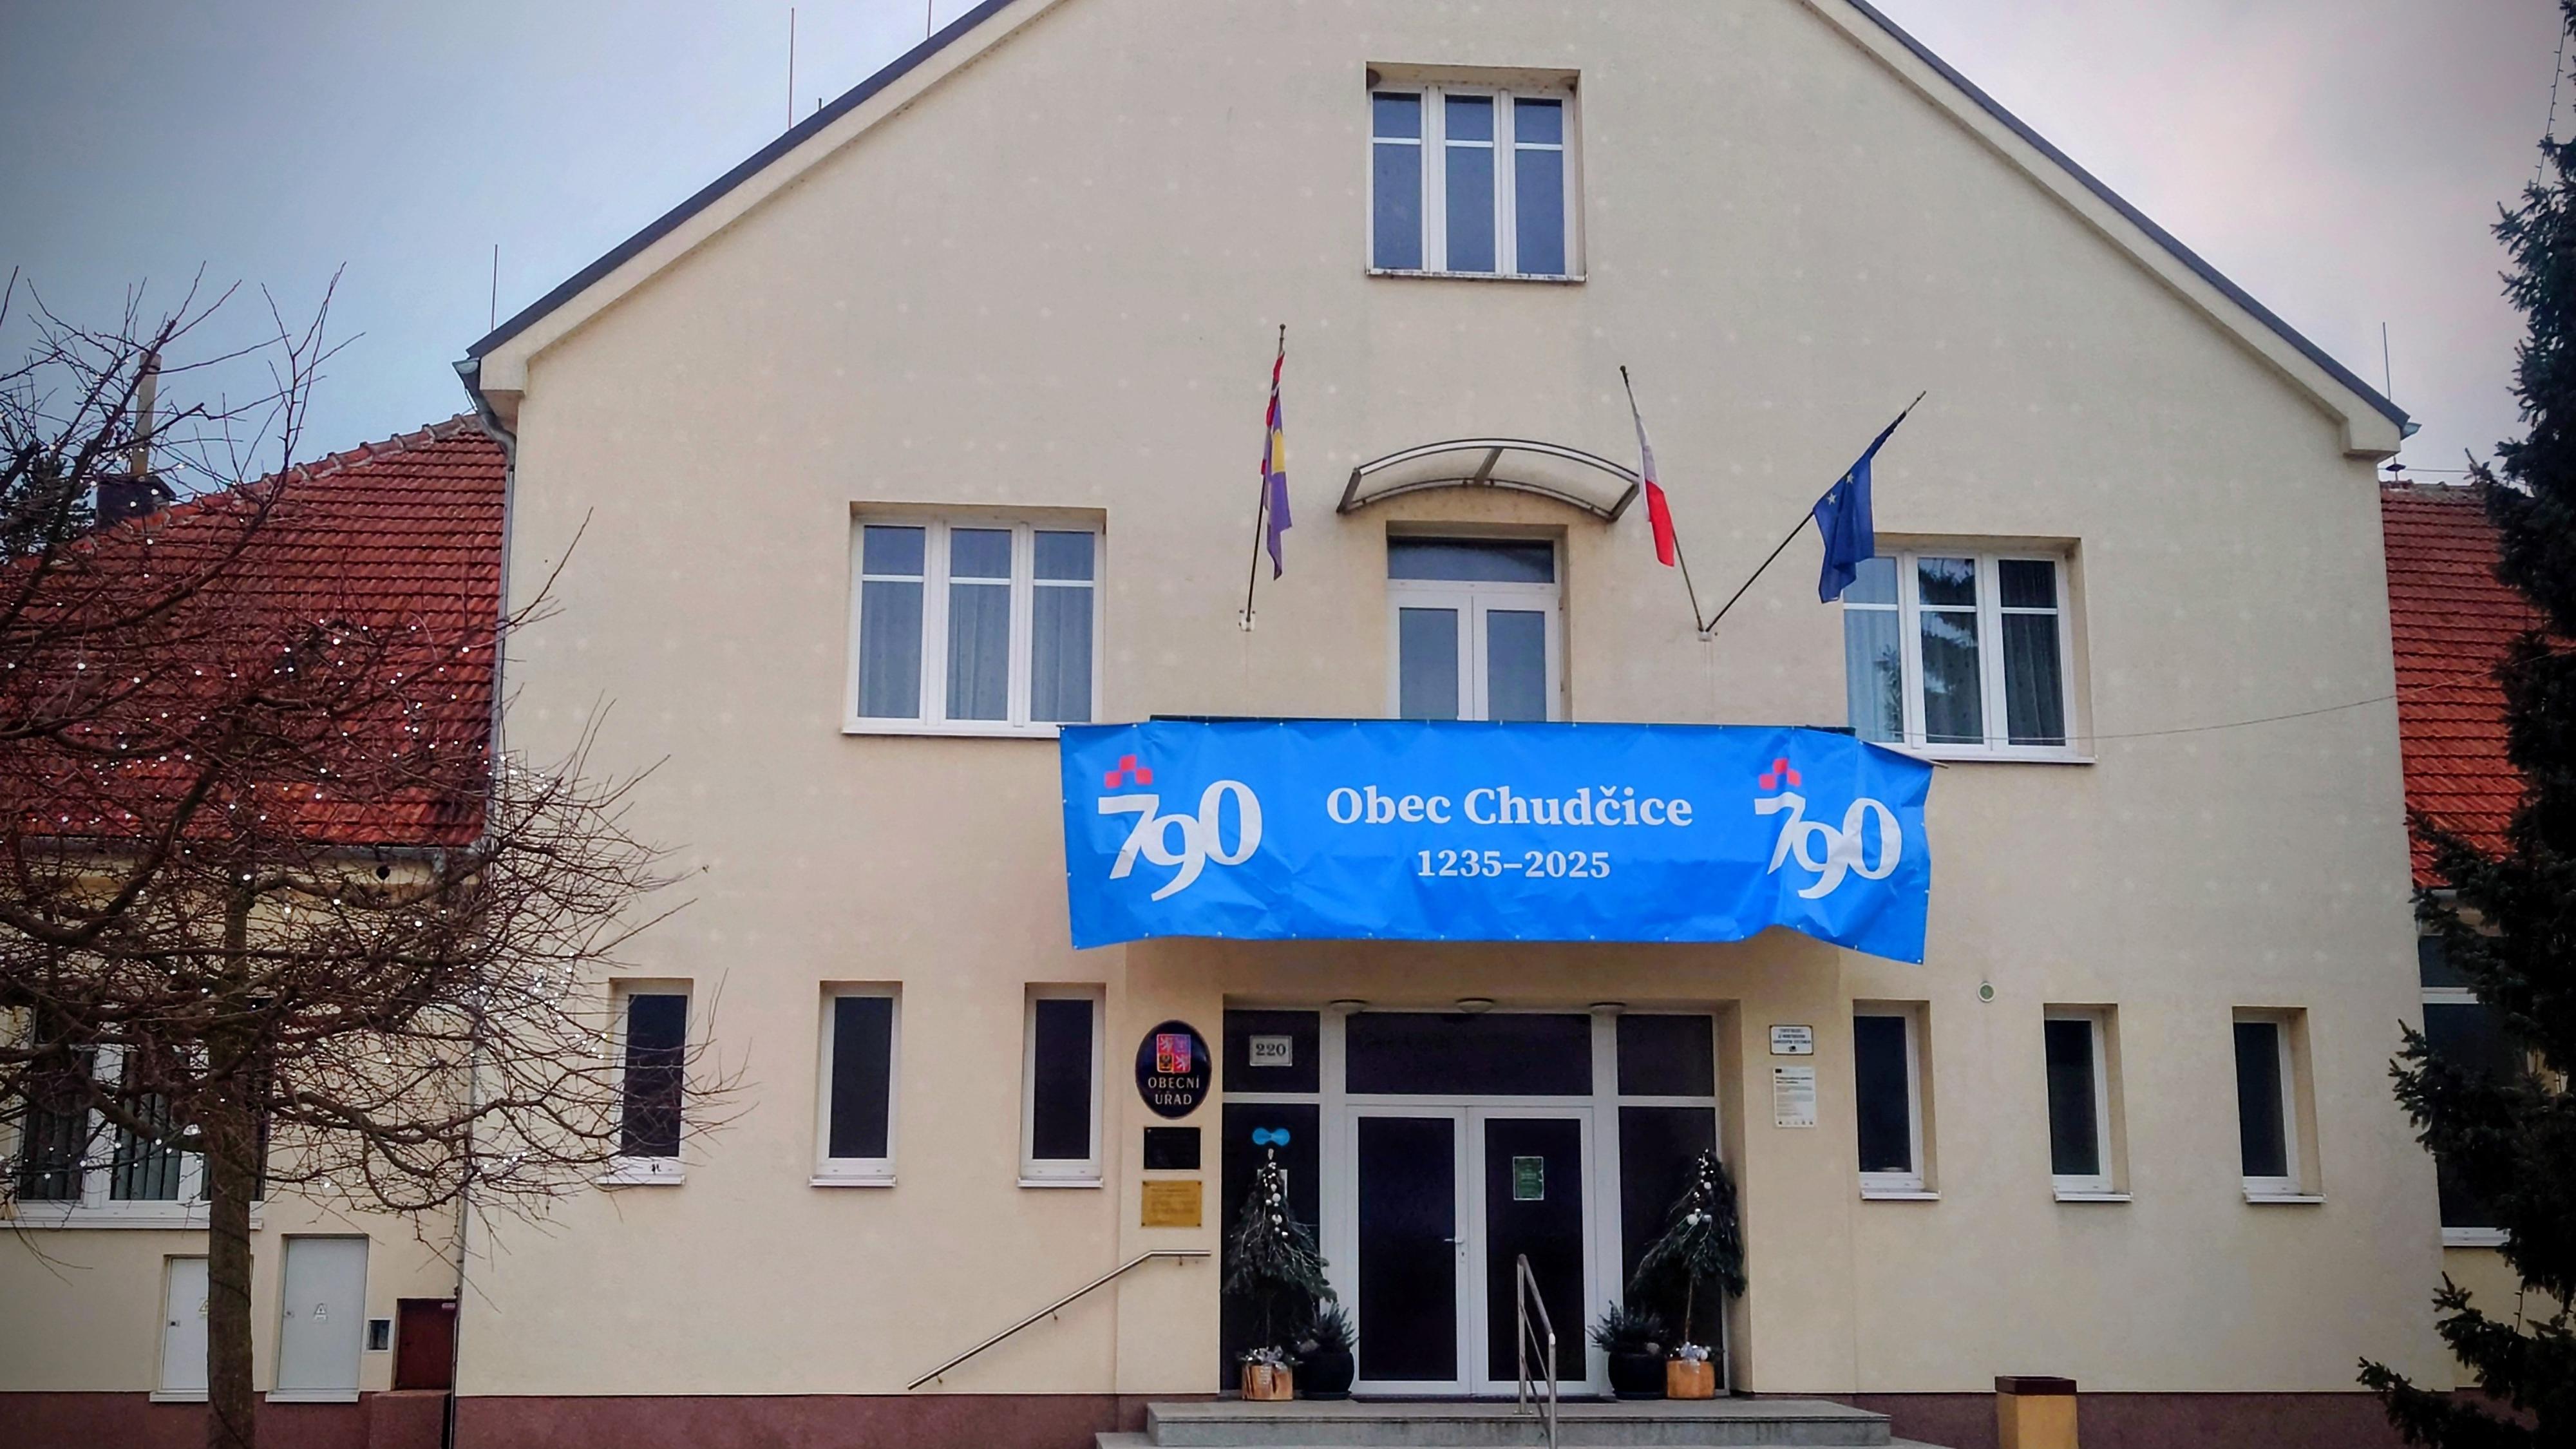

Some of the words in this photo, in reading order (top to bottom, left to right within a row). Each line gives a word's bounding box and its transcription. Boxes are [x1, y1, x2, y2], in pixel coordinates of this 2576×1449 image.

[1327, 787, 1451, 825] Obec
[1463, 786, 1693, 826] Chudčice
[1098, 780, 1262, 901] 790
[1754, 791, 1902, 900] 790
[1255, 1043, 1286, 1057] 220
[1148, 1075, 1200, 1089] OBECNÍ
[1155, 1090, 1192, 1105] ÚŘAD
